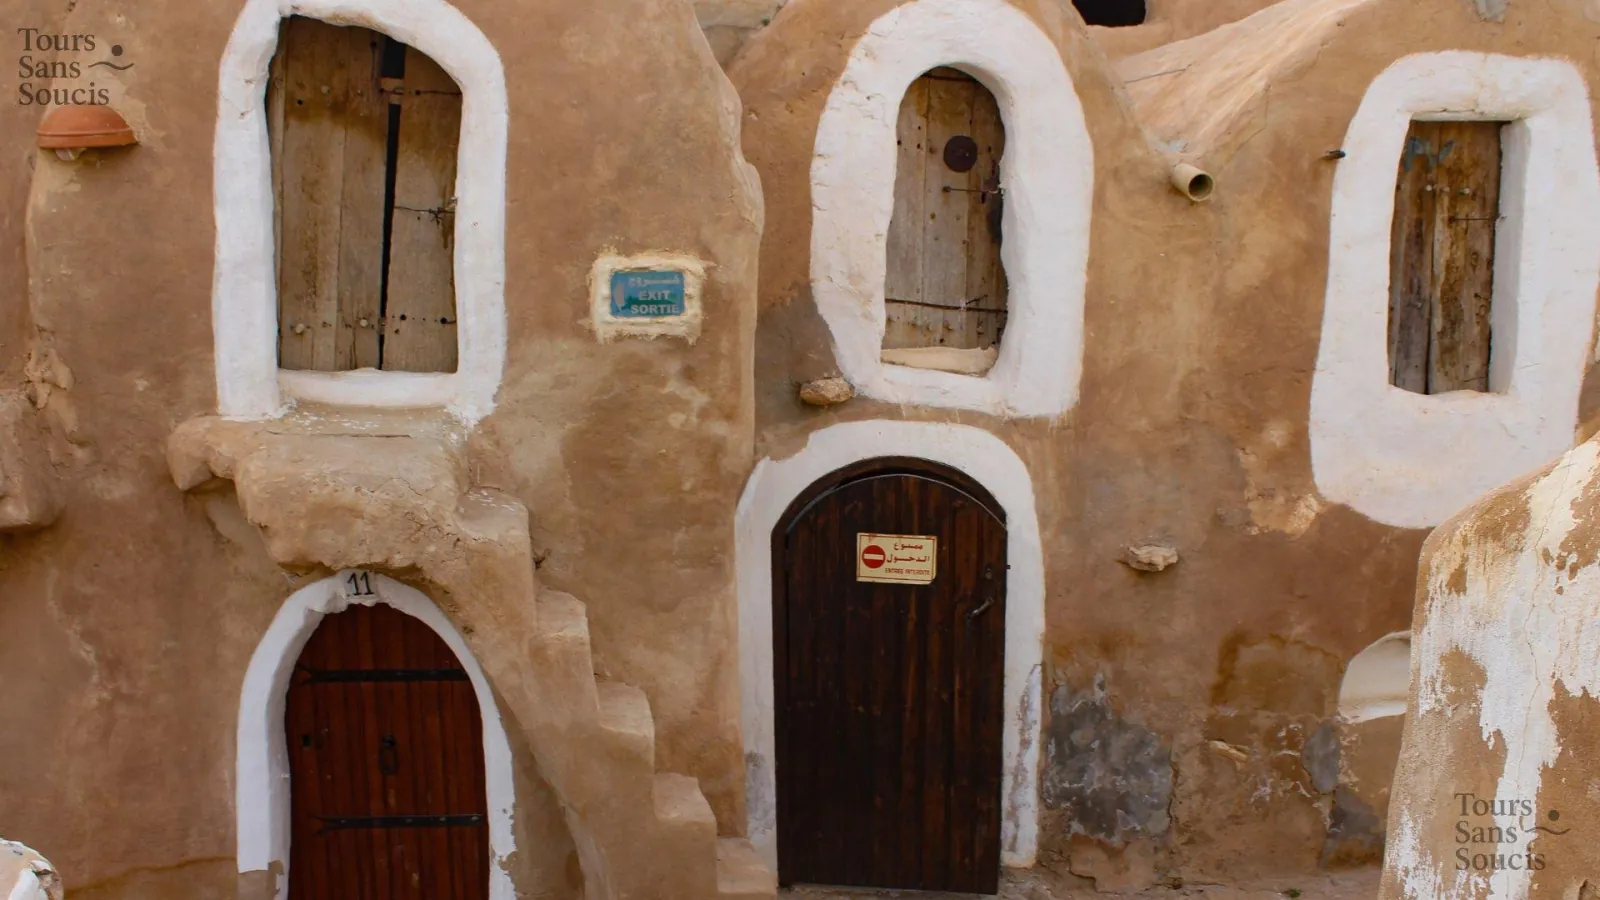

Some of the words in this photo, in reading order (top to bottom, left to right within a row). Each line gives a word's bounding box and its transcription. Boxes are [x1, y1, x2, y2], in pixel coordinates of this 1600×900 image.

[639, 290, 671, 301] EXIT
[630, 304, 680, 314] SORTIE
[893, 542, 923, 550] ممنوع
[886, 553, 930, 563] الدخول
[347, 571, 374, 595] 11
